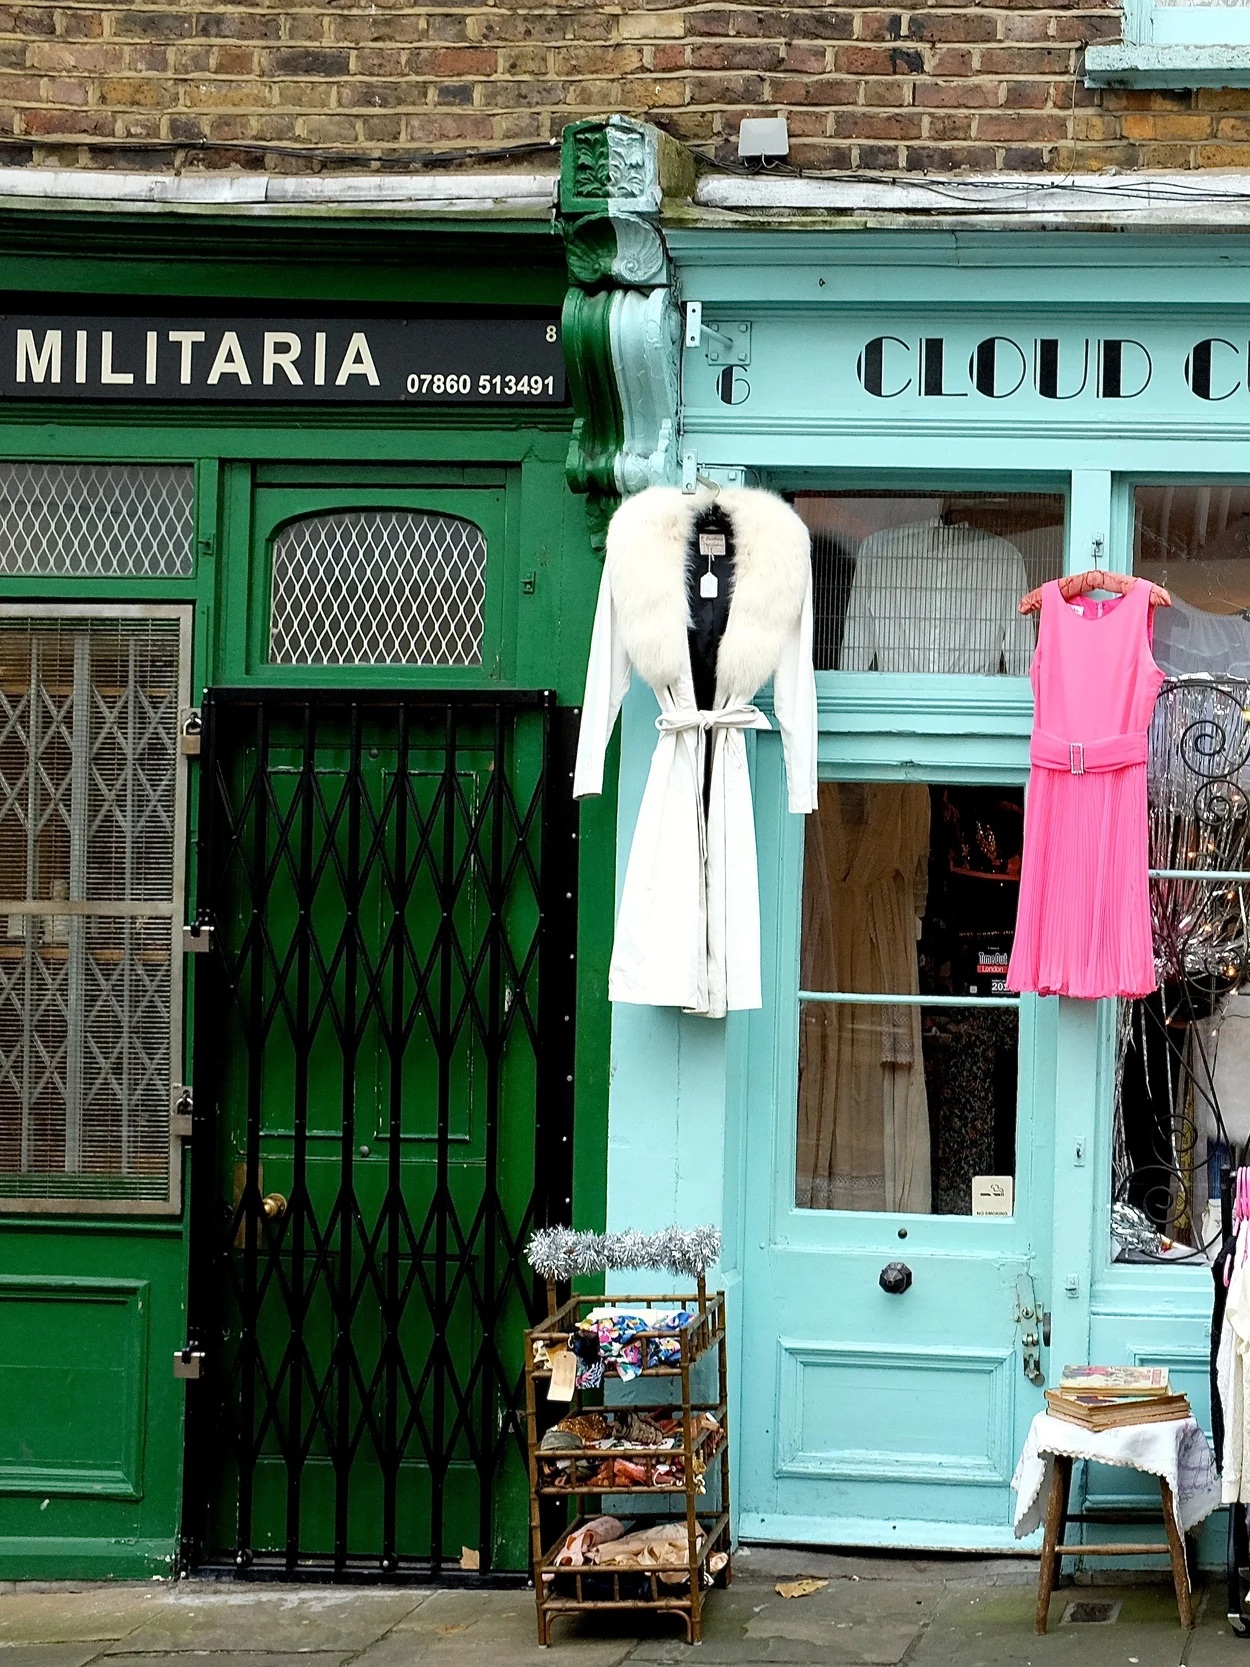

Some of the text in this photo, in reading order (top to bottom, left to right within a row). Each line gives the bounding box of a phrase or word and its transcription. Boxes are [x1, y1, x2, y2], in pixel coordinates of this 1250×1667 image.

[545, 325, 557, 342] 8
[16, 329, 380, 386] MILITARIA
[856, 336, 1152, 399] CLOUD
[406, 374, 554, 395] 07860 513491
[716, 364, 751, 405] 6
[982, 965, 1004, 973] London
